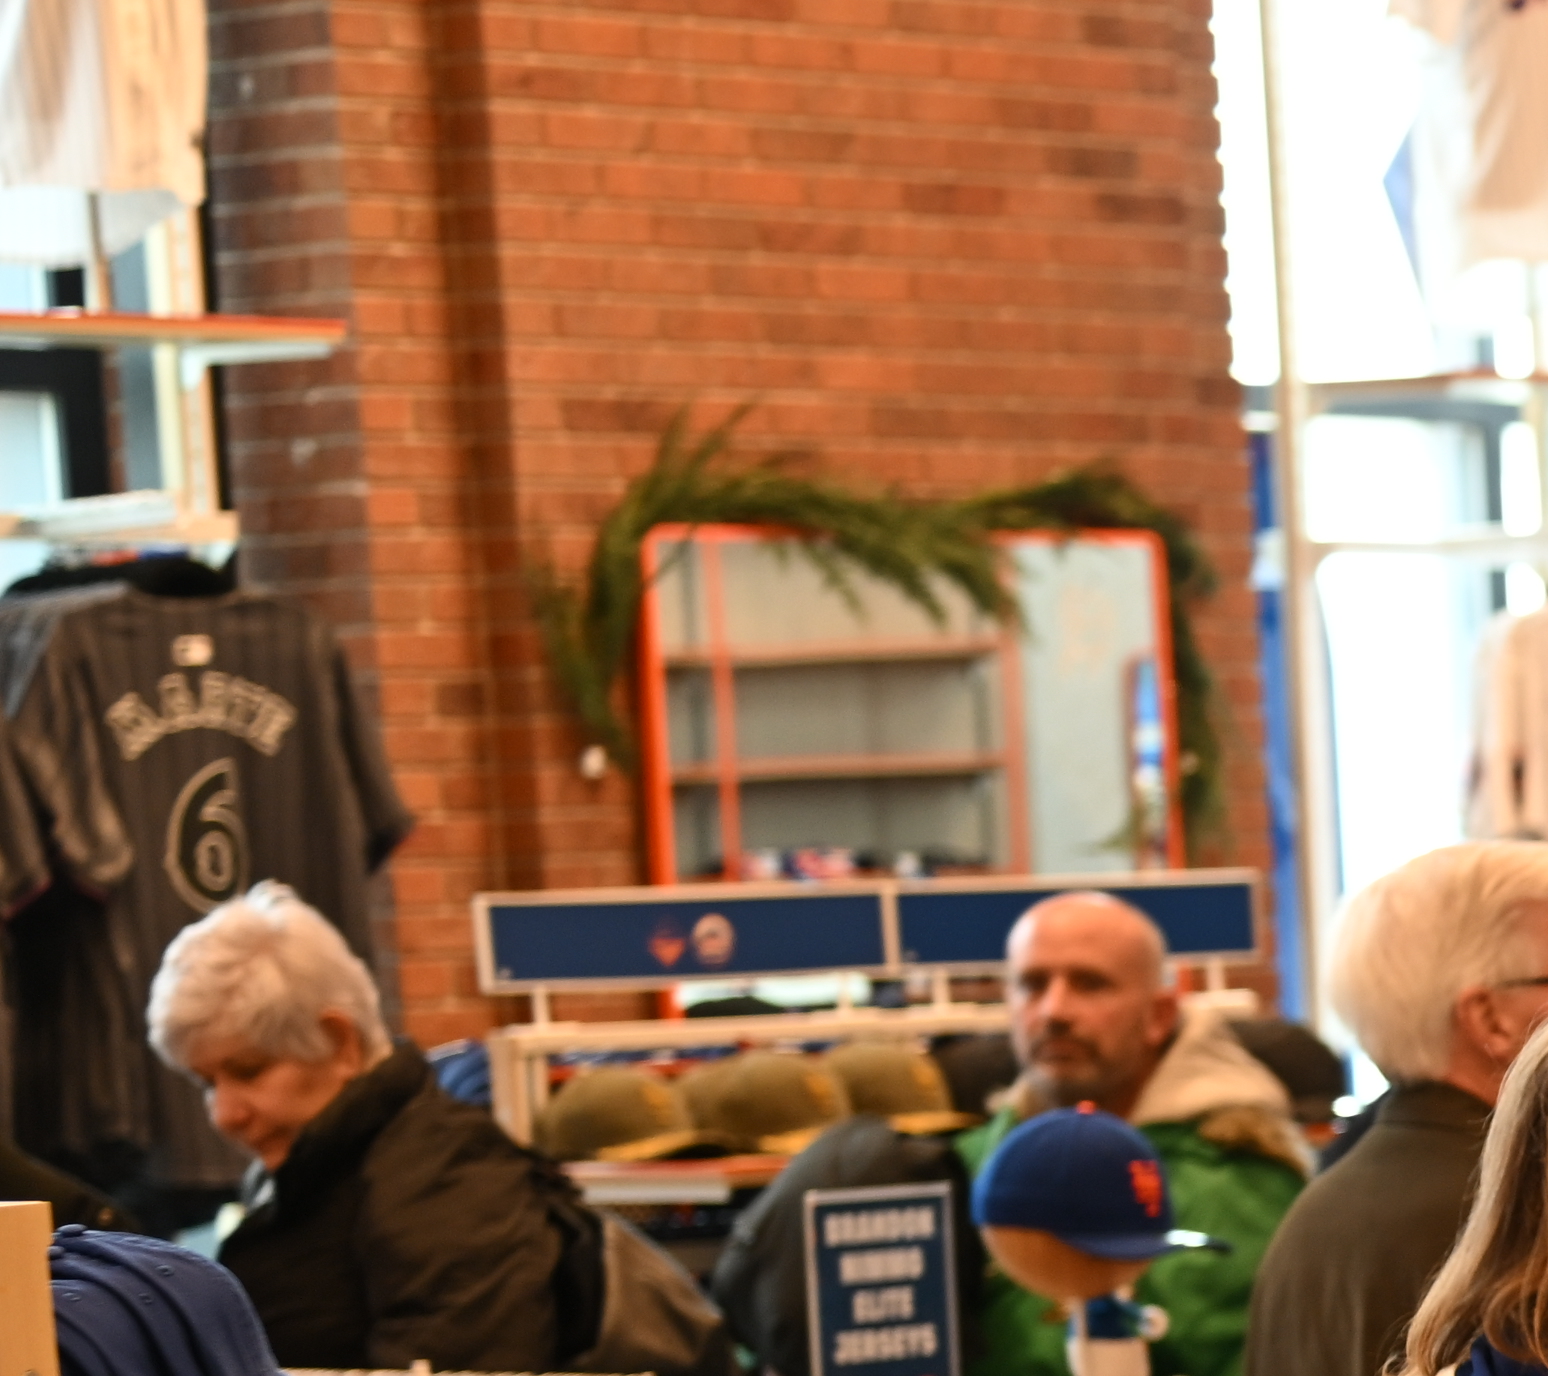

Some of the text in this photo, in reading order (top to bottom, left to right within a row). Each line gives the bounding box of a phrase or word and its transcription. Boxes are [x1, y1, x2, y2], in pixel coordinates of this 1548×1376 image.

[164, 755, 249, 916] 6
[823, 1205, 937, 1247] BRANDON
[837, 1245, 926, 1287] NIMMO
[851, 1284, 915, 1325] ELITE
[833, 1321, 938, 1367] JERSEYS
